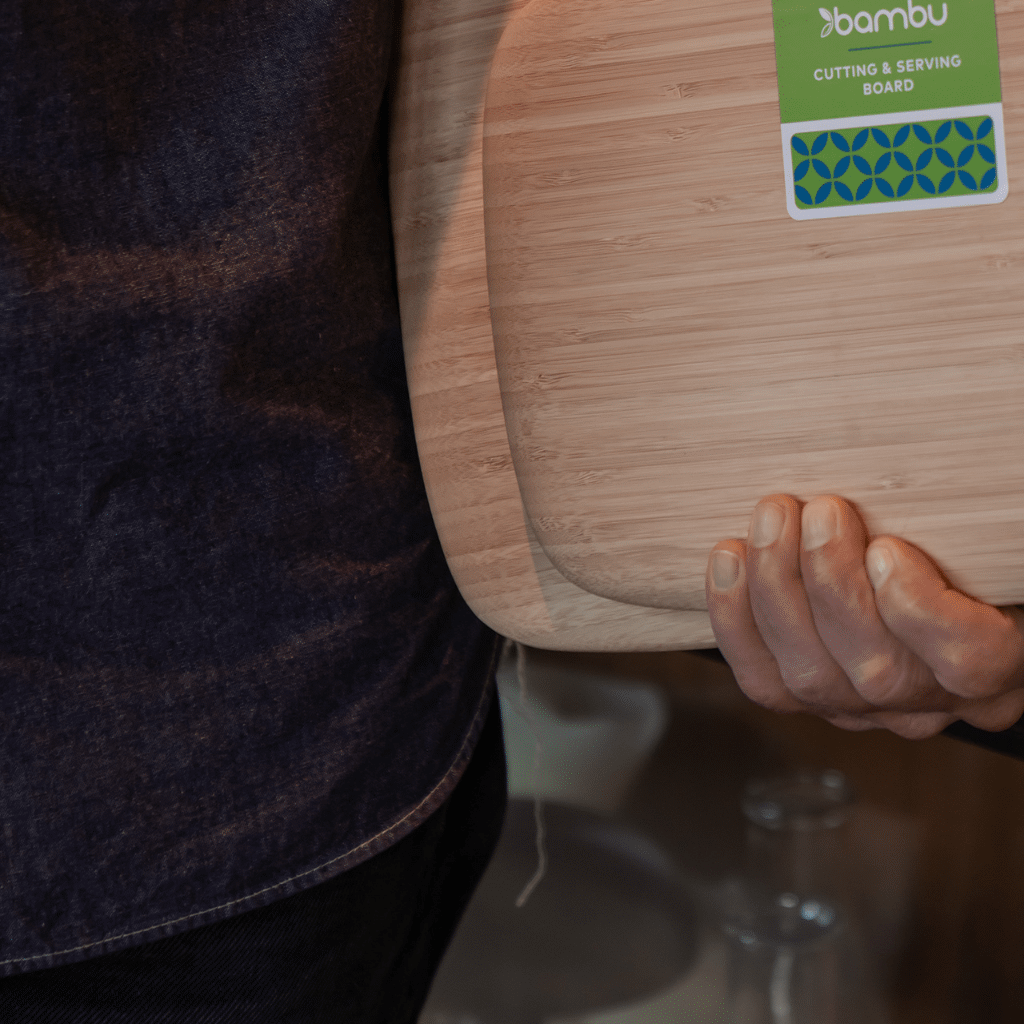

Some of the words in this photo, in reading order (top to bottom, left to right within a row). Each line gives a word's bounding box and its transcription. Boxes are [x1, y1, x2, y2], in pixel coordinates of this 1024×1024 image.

[813, 63, 878, 81] CUTTING
[882, 62, 892, 75] &
[896, 54, 962, 73] SERVING
[863, 78, 914, 96] BOARD
